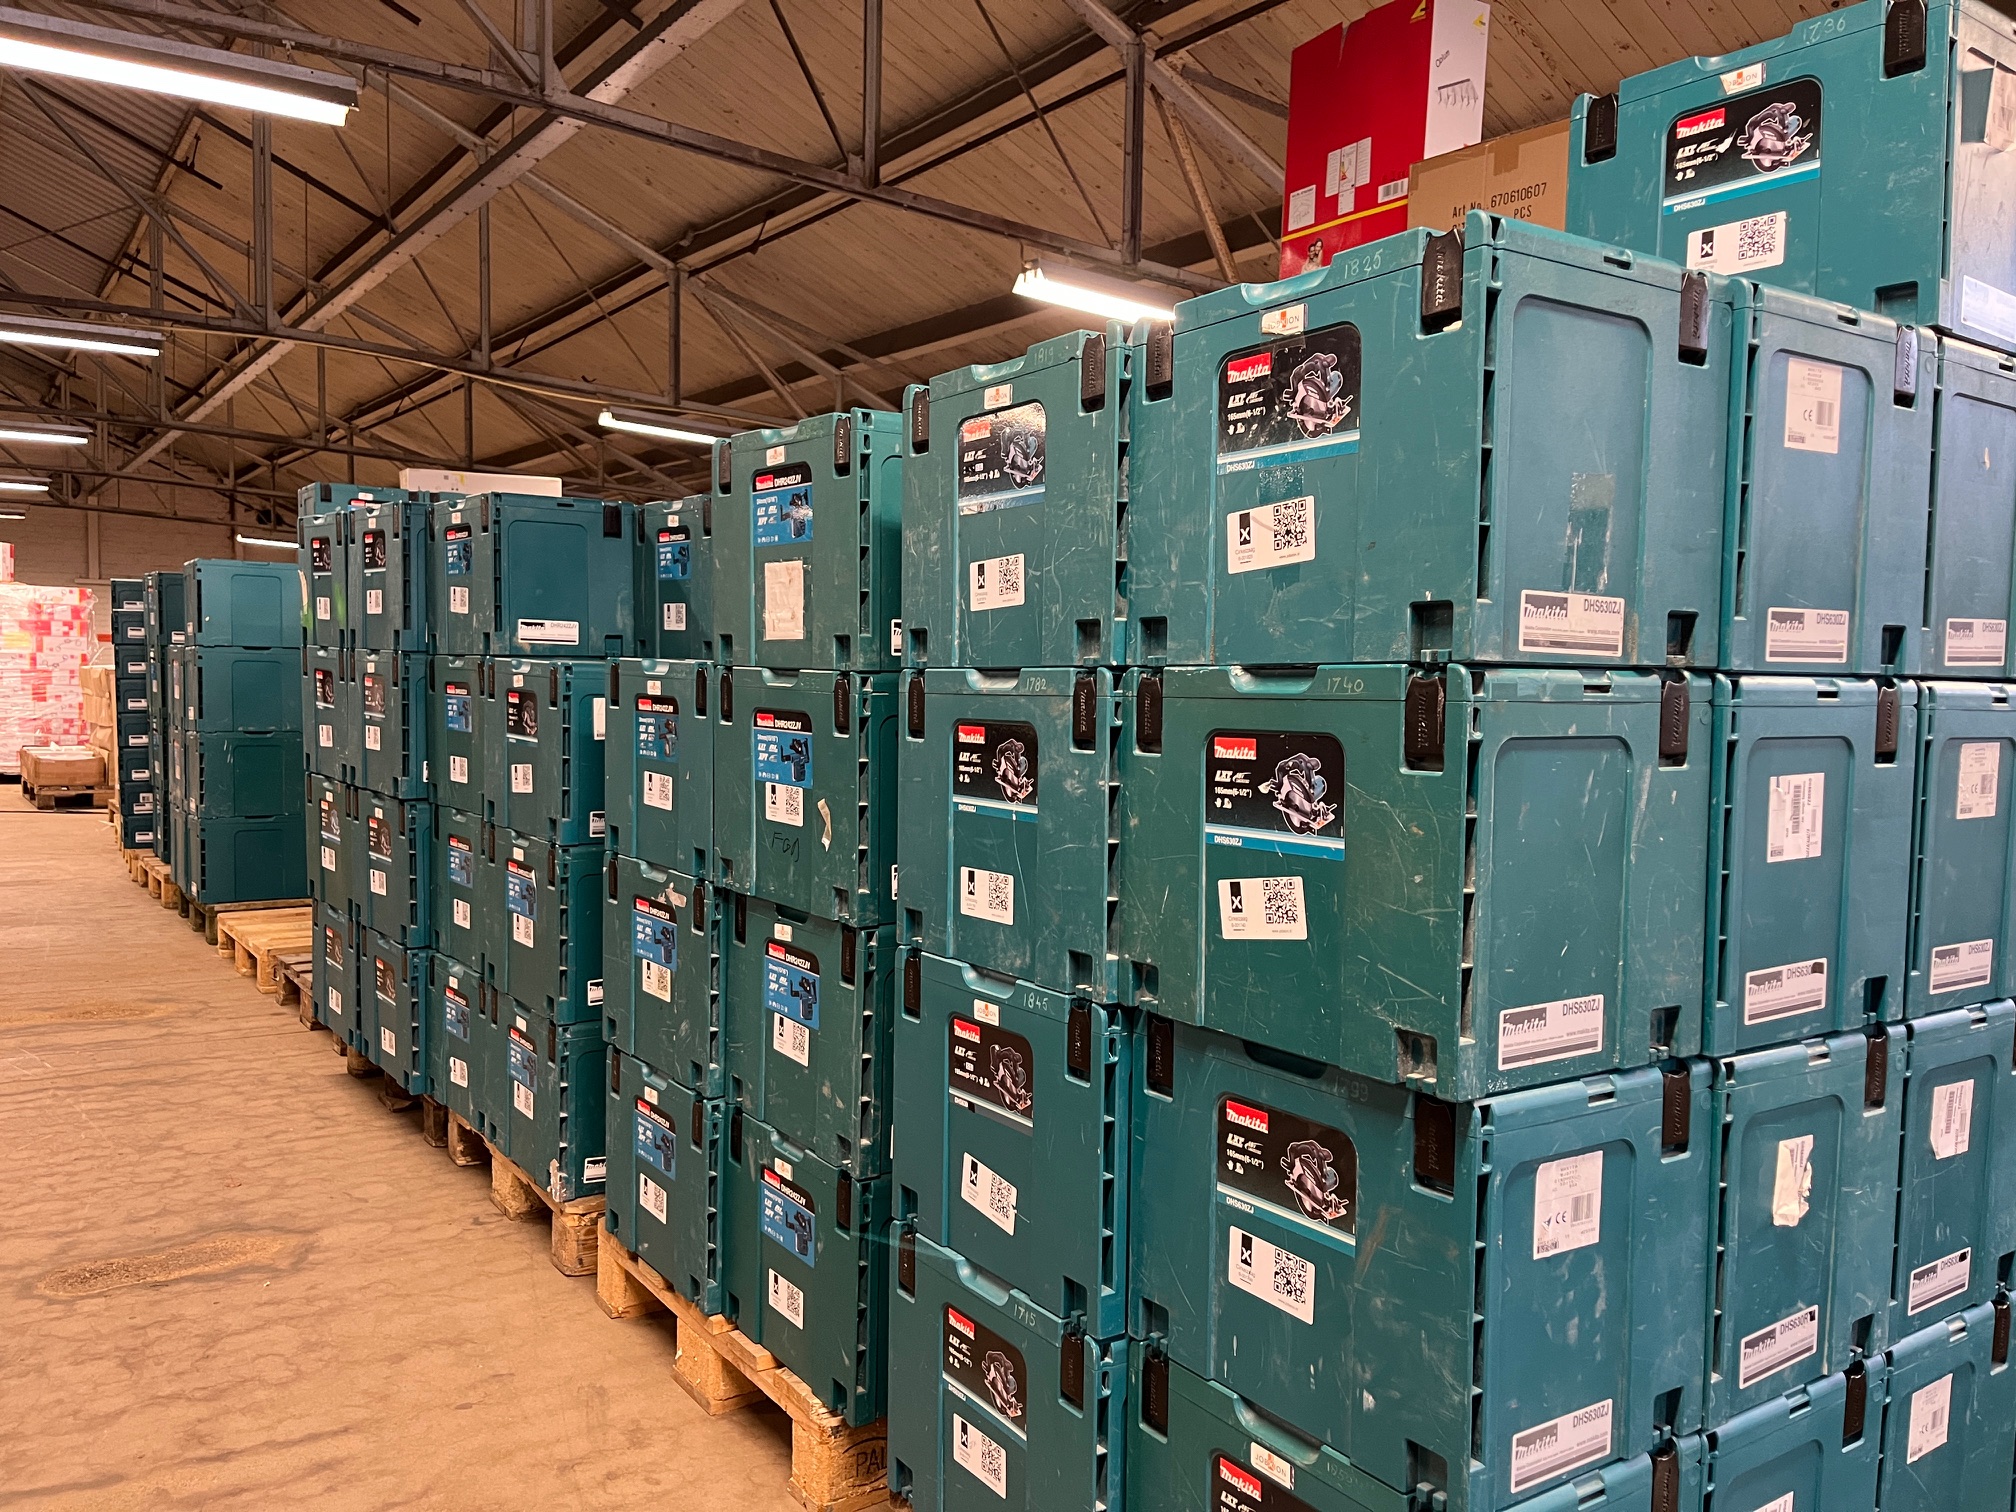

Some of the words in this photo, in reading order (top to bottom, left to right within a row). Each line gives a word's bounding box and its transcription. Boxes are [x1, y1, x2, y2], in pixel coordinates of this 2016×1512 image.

[1676, 117, 1726, 140] makita
[1452, 204, 1466, 219] Art
[1490, 181, 1548, 209] 670610607
[1513, 204, 1532, 219] PCS
[1343, 248, 1384, 280] 1825
[1227, 363, 1272, 384] makita
[1523, 602, 1568, 619] makita
[1583, 598, 1622, 615] DHS630ZJ
[1770, 619, 1805, 632] makita
[1026, 676, 1047, 692] 1782
[1327, 676, 1364, 693] 1740
[1214, 745, 1257, 761] makita
[1024, 992, 1049, 1011] 1845
[1502, 1017, 1547, 1037] makita
[1562, 998, 1601, 1017] DHS630ZJ
[1226, 1109, 1269, 1134] makita
[1013, 1303, 1037, 1327] 1715
[1515, 1434, 1558, 1461] makita
[1573, 1402, 1610, 1428] DHS630ZJ
[1219, 1465, 1262, 1503] makita
